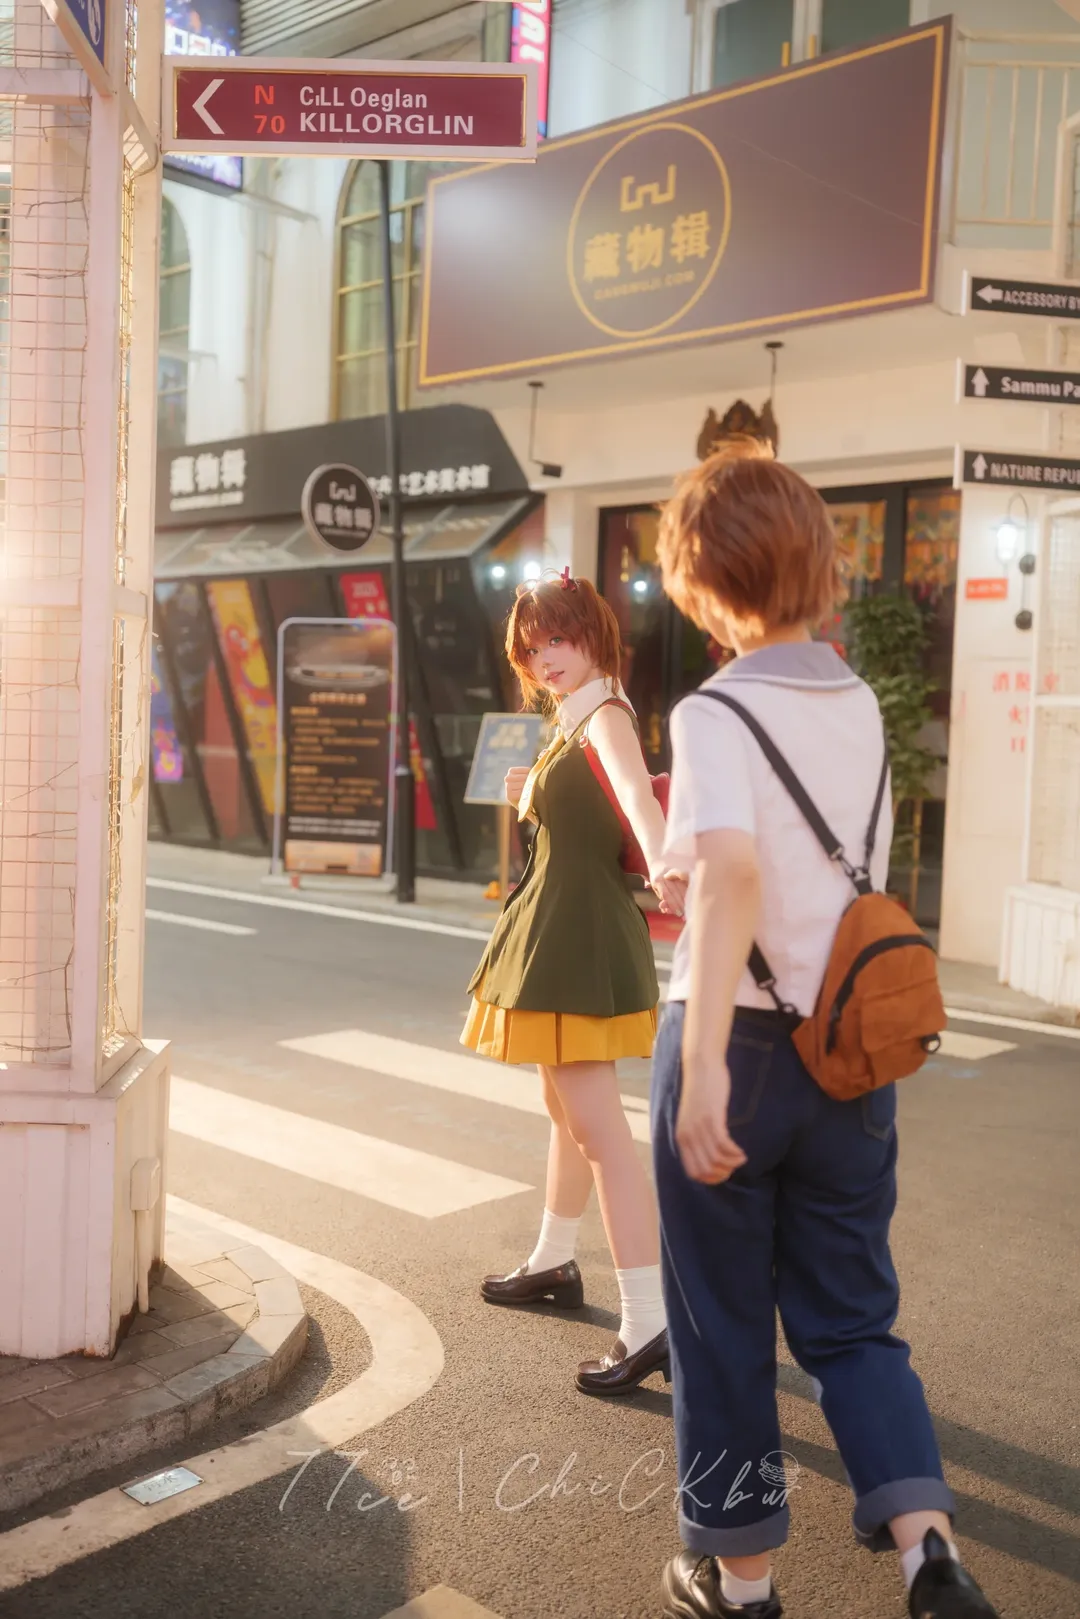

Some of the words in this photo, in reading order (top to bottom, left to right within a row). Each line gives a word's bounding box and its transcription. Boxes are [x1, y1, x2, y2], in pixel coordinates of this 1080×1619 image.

[254, 84, 275, 105] N
[350, 87, 428, 112] Oeglan
[253, 114, 286, 134] 70
[299, 112, 474, 136] KILLORGLIN
[1003, 289, 1067, 309] ACCESSORY
[1001, 376, 1061, 397] Sammu
[990, 462, 1042, 482] NATURE
[1043, 466, 1080, 485] REPU
